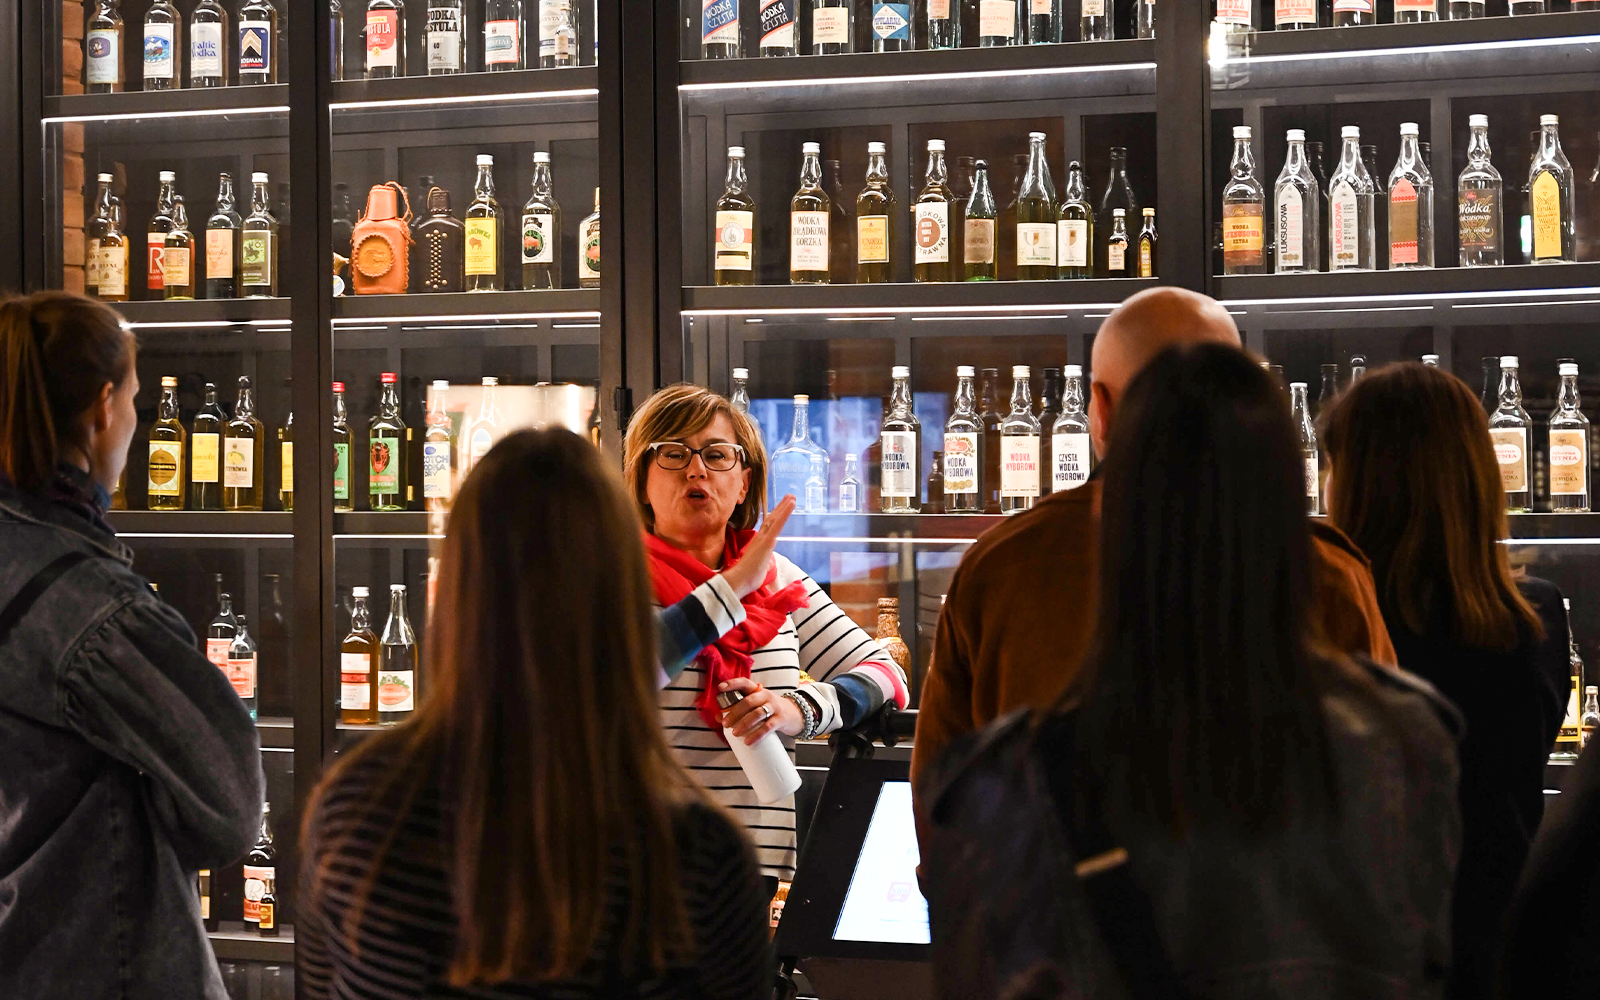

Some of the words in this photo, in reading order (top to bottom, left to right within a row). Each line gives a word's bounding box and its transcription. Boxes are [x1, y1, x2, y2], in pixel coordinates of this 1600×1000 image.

[705, 0, 732, 20] WÓDKA
[708, 10, 736, 29] CZYSTA
[761, 2, 786, 23] WÓDKA
[763, 12, 789, 32] CZYSTA
[1459, 203, 1490, 214] Wódka
[798, 215, 821, 226] WÓDKA
[1280, 203, 1288, 254] LUKSUSOWA
[1334, 202, 1343, 253] LUKSUSOWA
[1006, 462, 1036, 471] WYBOROWA
[1058, 453, 1078, 462] CZYSTA
[1055, 472, 1086, 481] WYBOROWA
